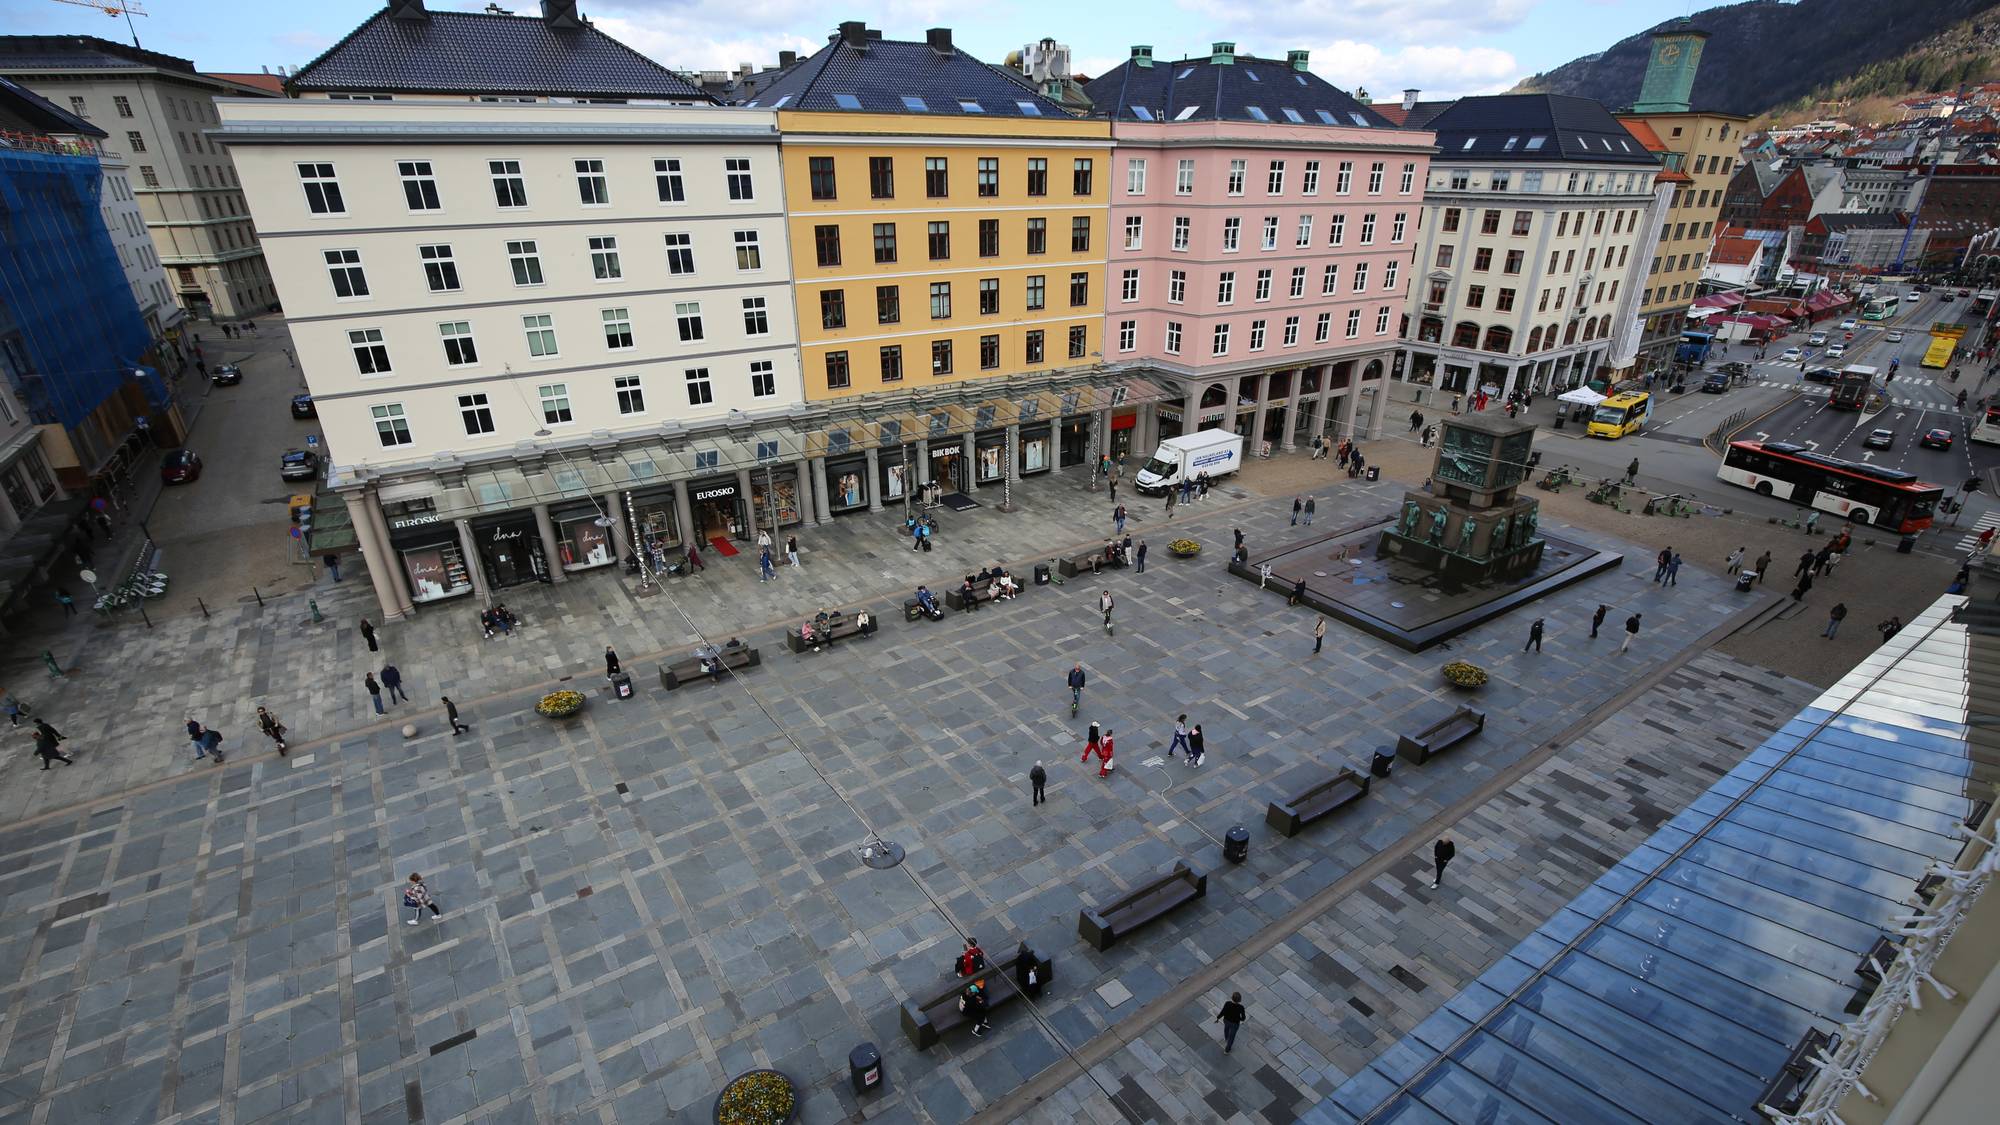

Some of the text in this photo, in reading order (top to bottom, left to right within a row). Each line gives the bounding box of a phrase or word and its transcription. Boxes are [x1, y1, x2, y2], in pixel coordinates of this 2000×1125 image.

[932, 445, 960, 458] BIK BOK
[696, 487, 735, 500] EUROSKO
